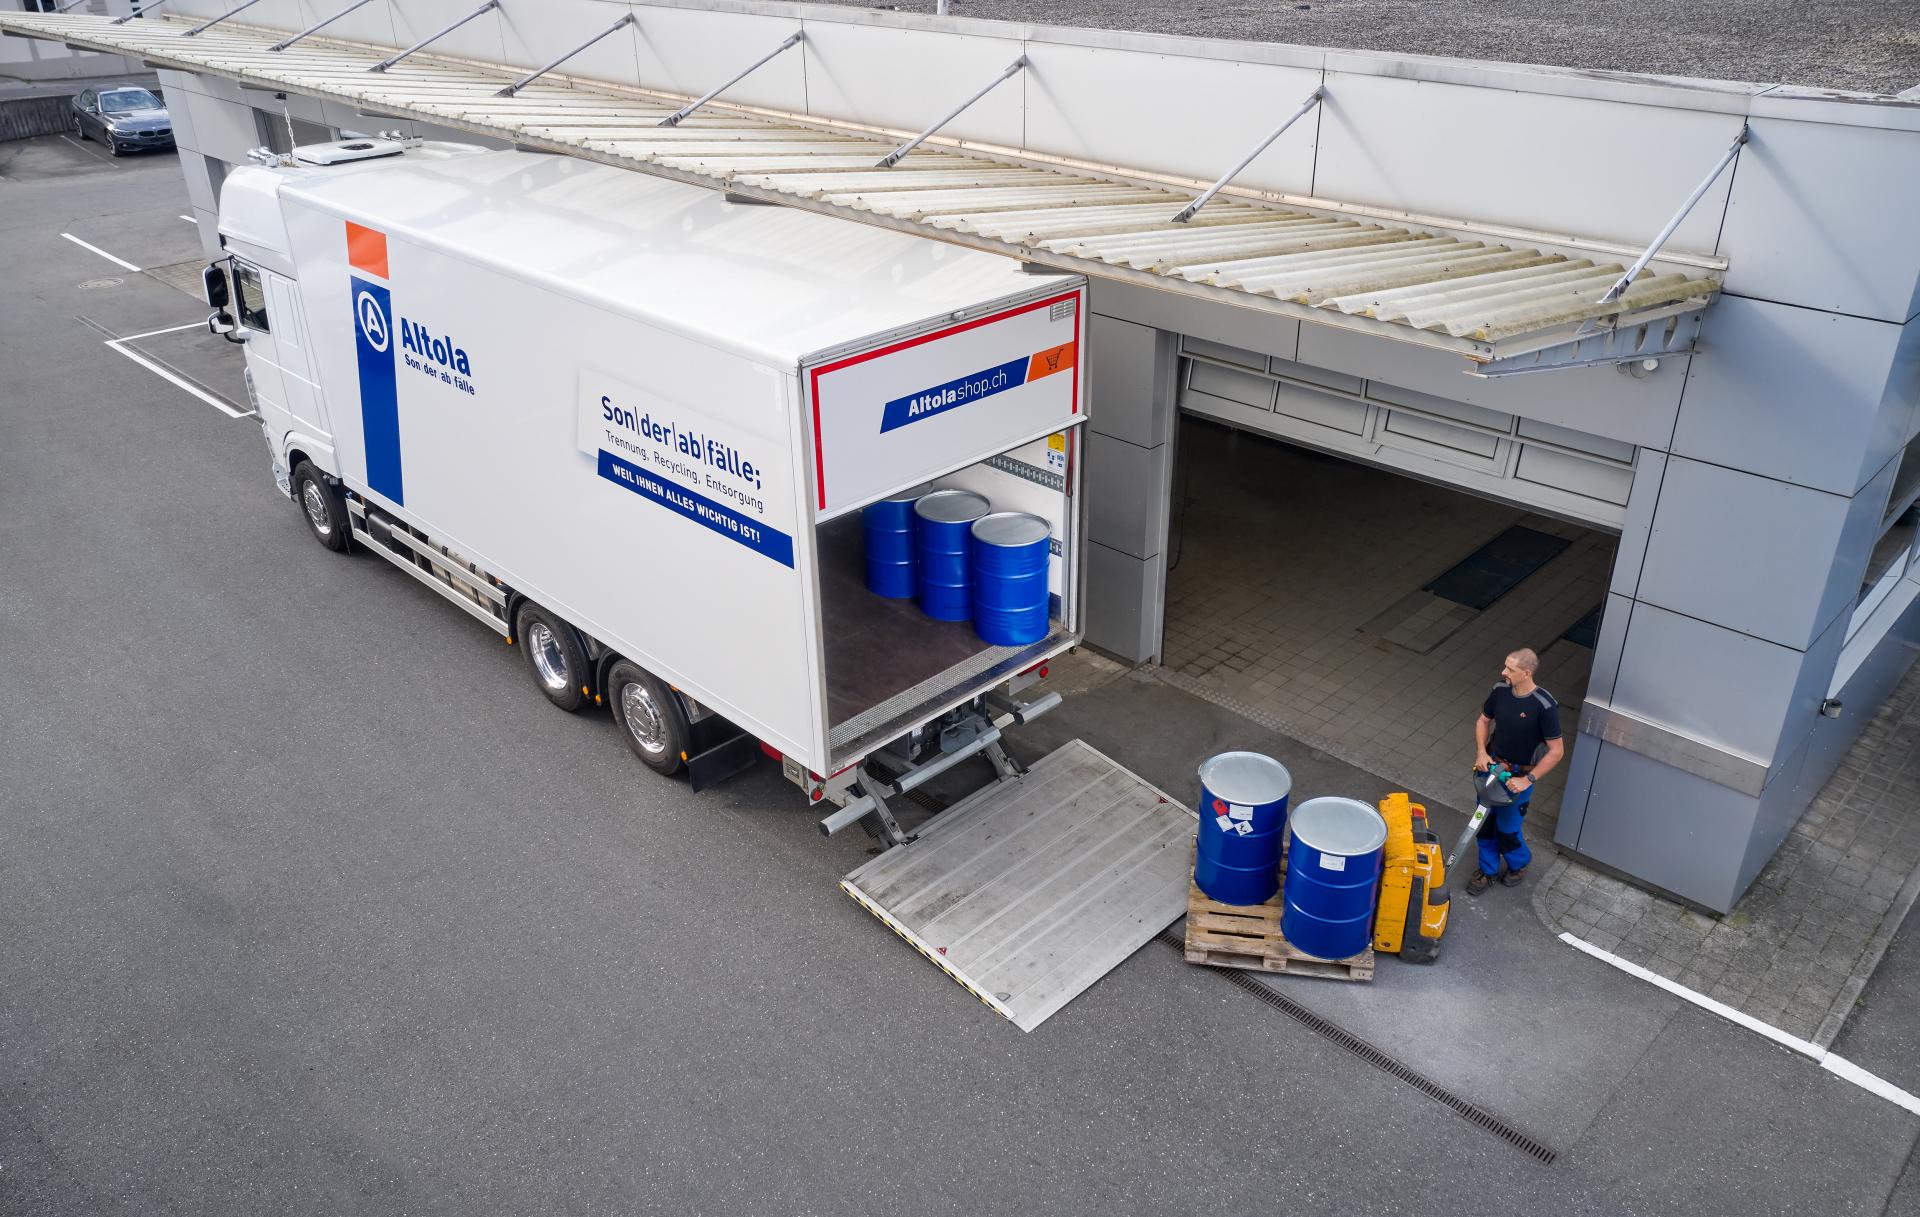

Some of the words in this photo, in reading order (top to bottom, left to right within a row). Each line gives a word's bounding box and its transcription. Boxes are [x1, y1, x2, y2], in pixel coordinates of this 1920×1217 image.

[401, 317, 472, 377] Altola
[908, 369, 1007, 417] Altolashop.ch
[605, 429, 650, 462] Trennung,
[653, 450, 701, 485] Recycling,
[705, 473, 764, 514] Entsorgung
[612, 463, 636, 486] WEIL
[635, 474, 664, 498] IHNEN
[666, 489, 695, 512] ALLES
[695, 502, 738, 532] WICHTIG
[739, 523, 761, 543] IST!
